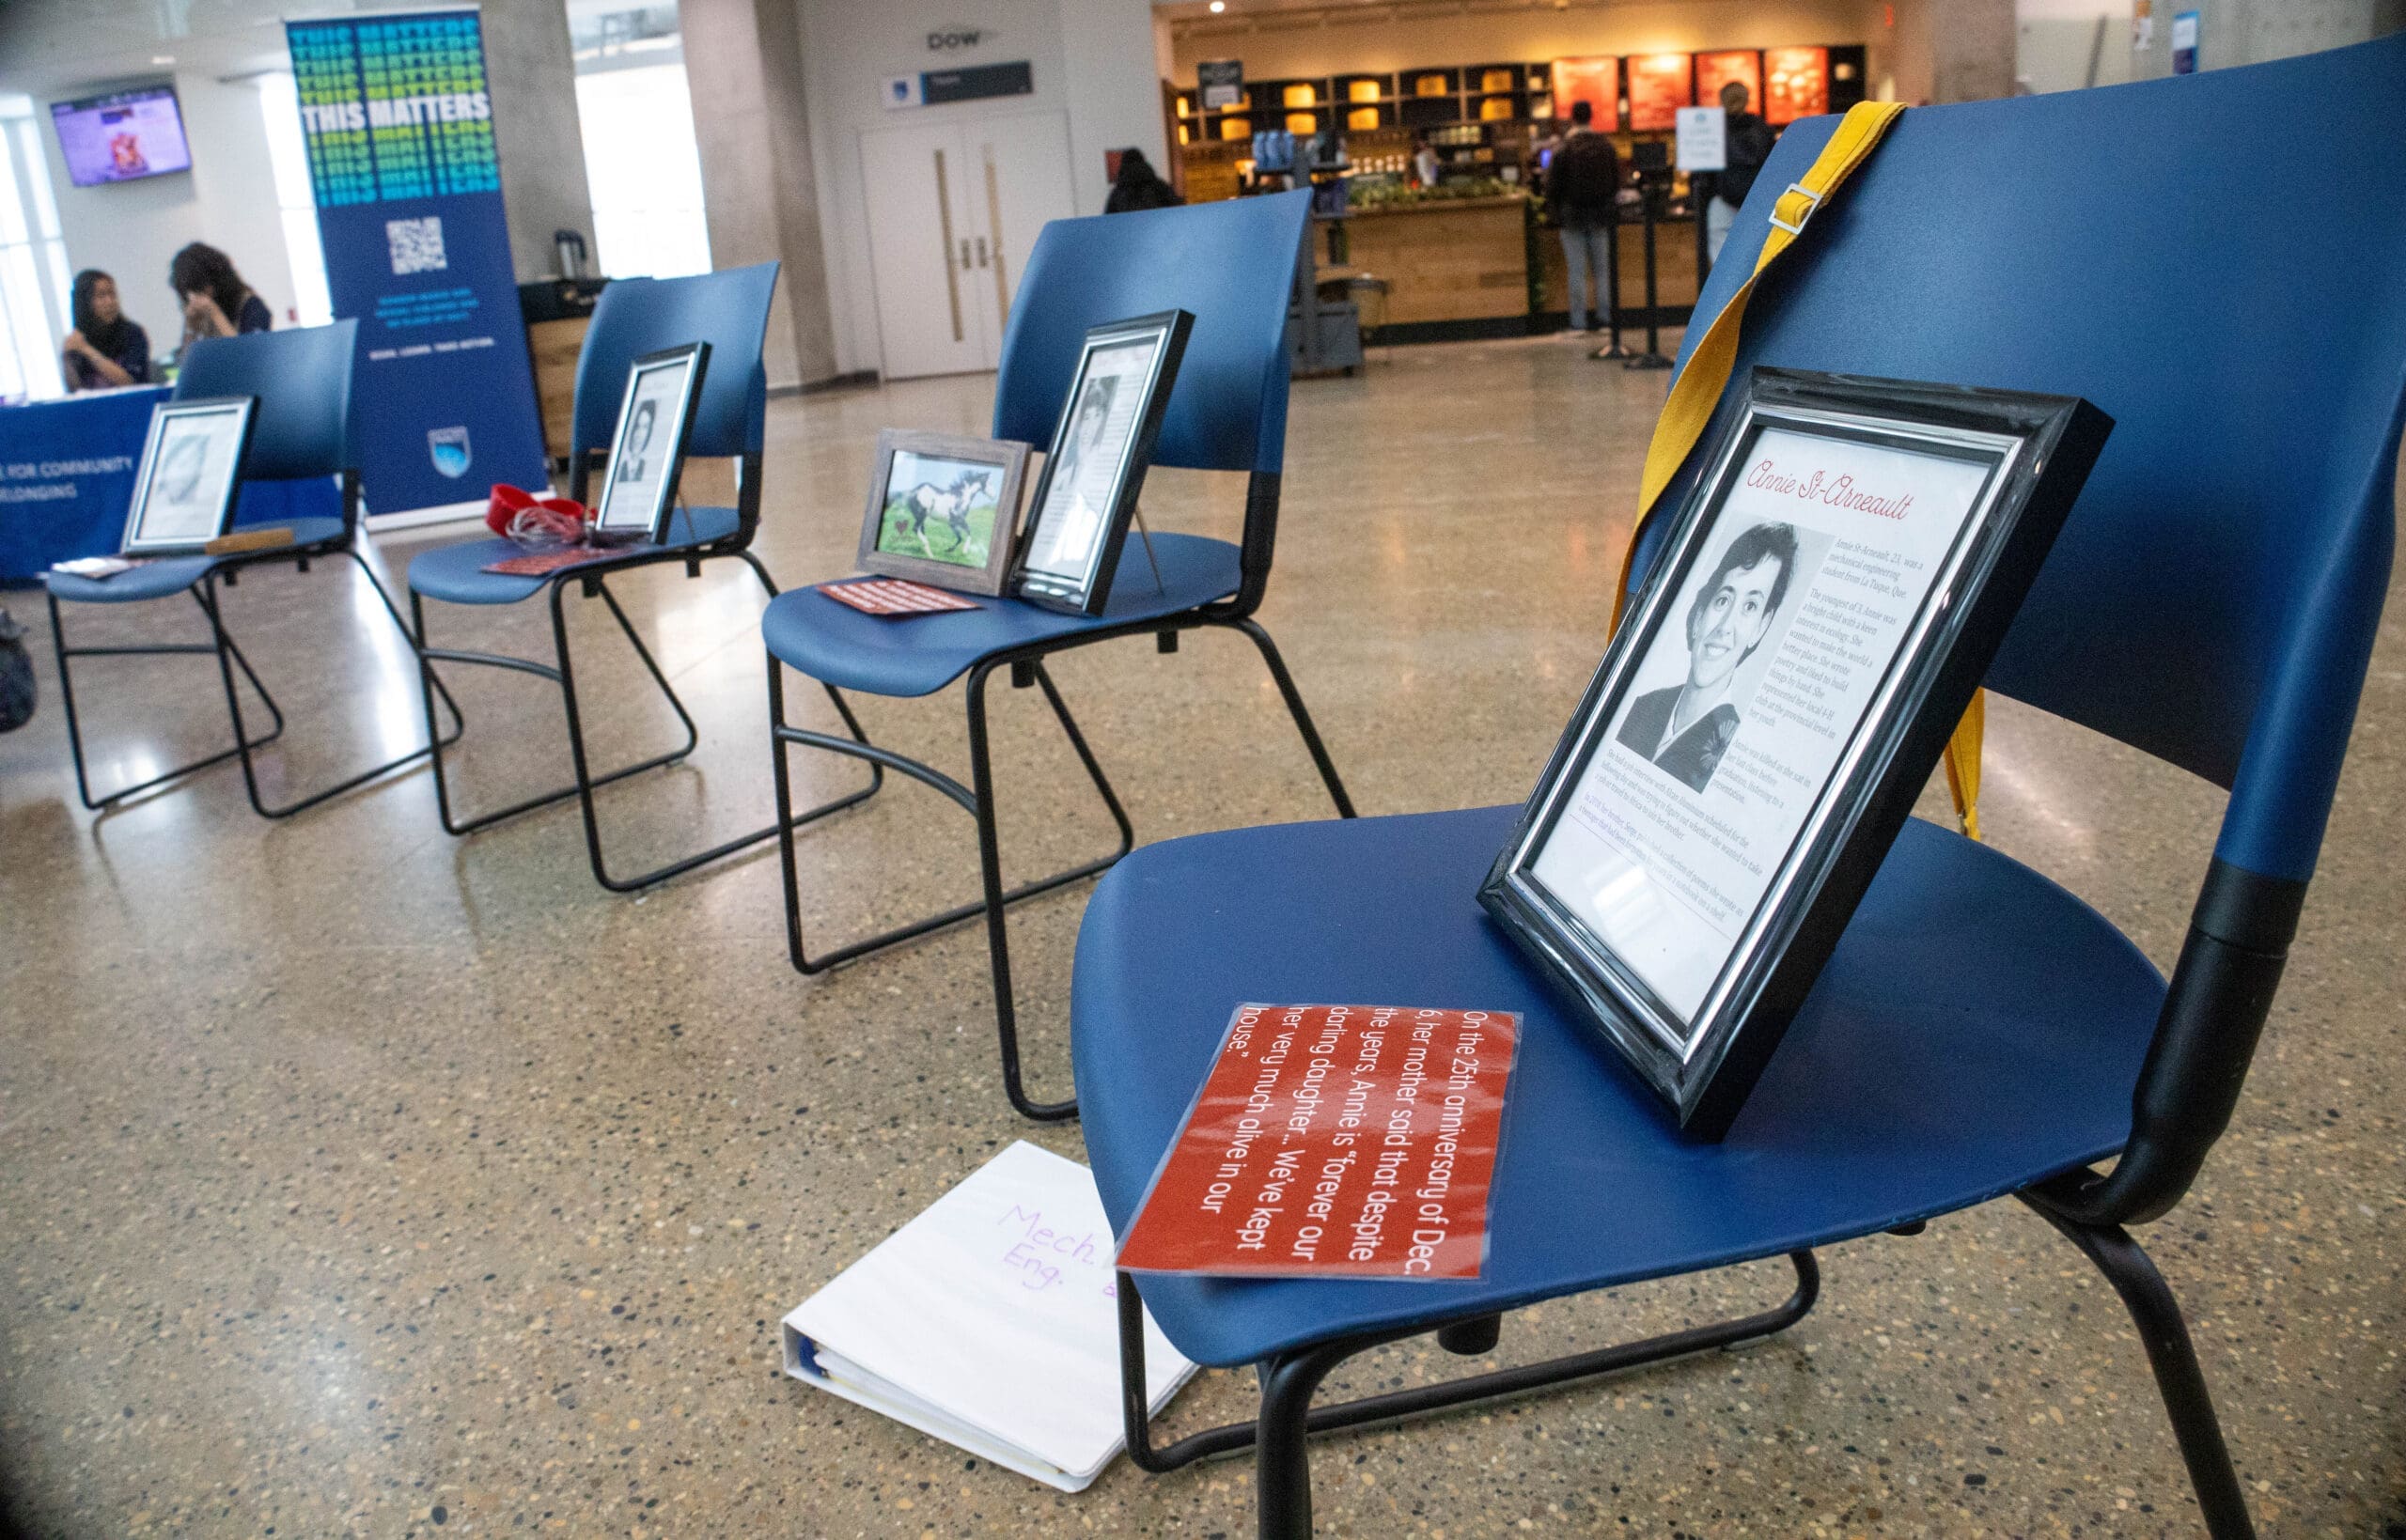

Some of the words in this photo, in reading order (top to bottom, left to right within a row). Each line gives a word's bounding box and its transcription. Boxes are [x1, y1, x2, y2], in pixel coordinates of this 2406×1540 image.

[928, 30, 980, 51] DOW
[303, 101, 366, 133] THIS
[367, 90, 491, 128] MATTERS
[7, 462, 37, 479] FOR
[39, 455, 133, 478] COMMUNITY
[1746, 459, 1796, 494] Annie
[1798, 470, 1914, 520] St-Arneault
[1281, 1004, 1305, 1029] her
[1308, 1004, 1350, 1054] darling
[1369, 1007, 1398, 1028] the
[1414, 1009, 1444, 1019] 6,
[1461, 1011, 1488, 1028] On
[1259, 1031, 1295, 1065] very
[1412, 1022, 1441, 1043] her
[1455, 1032, 1485, 1054] the
[1350, 1031, 1385, 1076] years,
[1245, 1068, 1280, 1112] much
[1396, 1047, 1428, 1105] mother
[1447, 1057, 1479, 1090] 25th
[1338, 1079, 1376, 1128] Annie
[1226, 1118, 1264, 1159] alive
[1332, 1132, 1361, 1146] is
[1383, 1110, 1413, 1145] said
[1415, 1095, 1465, 1199] anniversary
[1216, 1163, 1247, 1178] in
[1371, 1150, 1409, 1187] that
[1200, 1182, 1231, 1214] our
[1417, 1203, 1449, 1224] of
[997, 1204, 1094, 1264] Mech.
[1235, 1207, 1284, 1251] kept
[1290, 1225, 1323, 1261] our
[1348, 1190, 1396, 1261] despite
[1004, 1242, 1063, 1290] Eng.
[1404, 1229, 1445, 1275] Dec.
